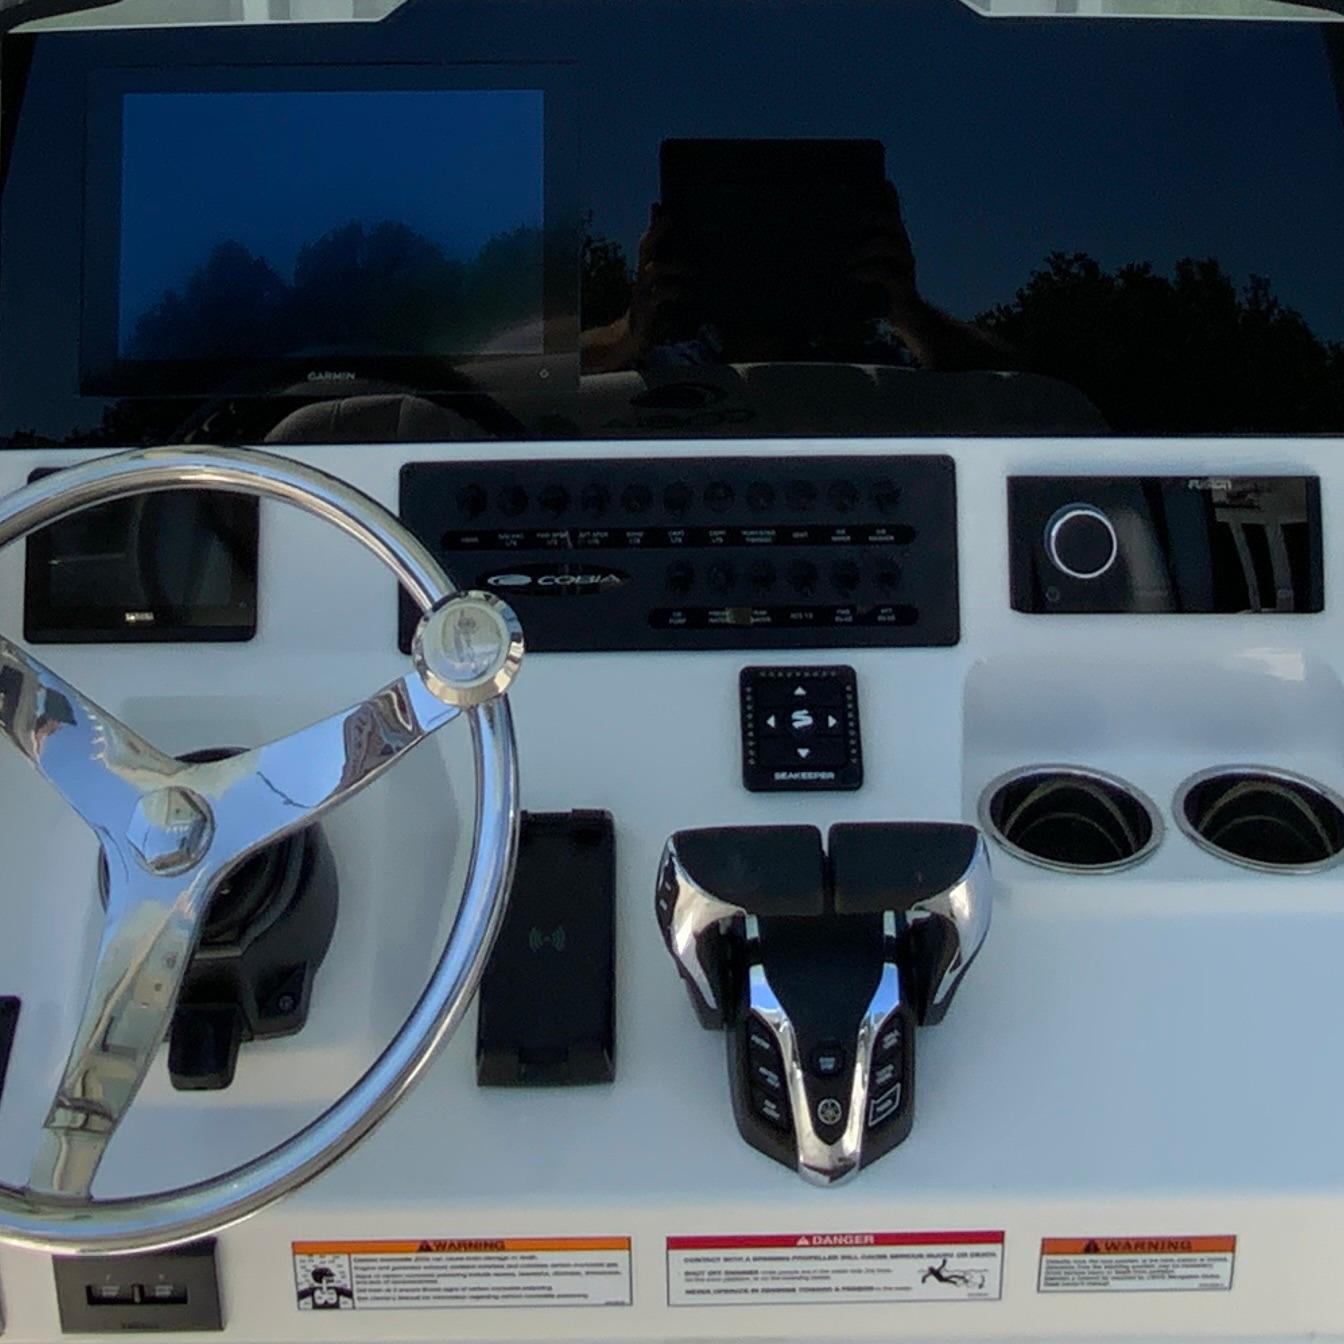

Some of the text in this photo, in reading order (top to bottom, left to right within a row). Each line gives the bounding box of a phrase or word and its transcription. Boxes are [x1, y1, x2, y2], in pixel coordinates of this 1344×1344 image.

[307, 370, 356, 382] GARMIN
[774, 771, 835, 781] SEAKEEPER
[433, 1239, 506, 1252] WARNING
[812, 1234, 874, 1246] DANGER
[1104, 1239, 1193, 1252] WARNING
